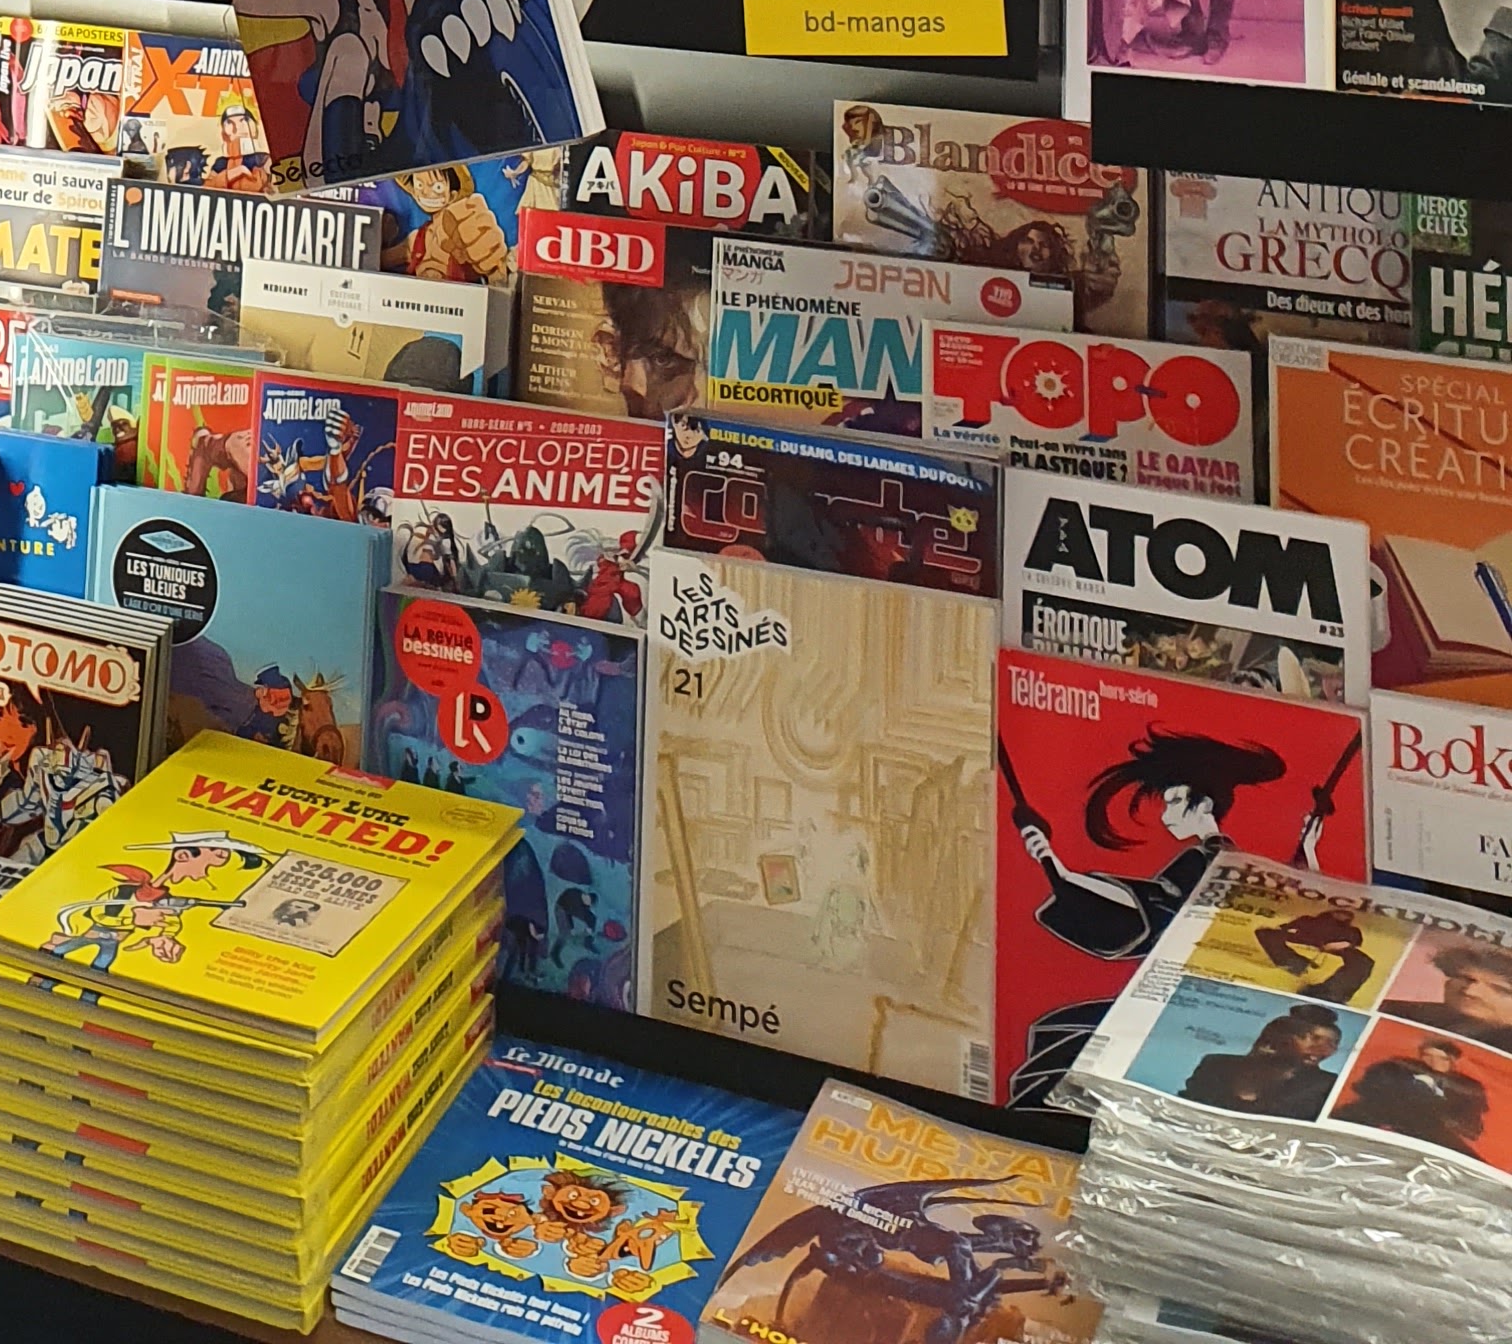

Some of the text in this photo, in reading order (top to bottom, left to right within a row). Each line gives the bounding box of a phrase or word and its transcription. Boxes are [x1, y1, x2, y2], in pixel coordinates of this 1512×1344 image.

[804, 10, 946, 40] bd-mangas
[1343, 70, 1485, 97] Géniale et scandaleuse
[1416, 216, 1469, 239] CELTES
[534, 225, 656, 275] dBD
[722, 252, 786, 274] MANGA
[263, 282, 309, 298] MEDIAPART
[933, 328, 1241, 446] TOPO
[1400, 373, 1504, 406] SPÉCIAL
[407, 433, 660, 472] ENCYCLOPÉDIE
[126, 559, 206, 588] LES TUNIQUES
[1023, 496, 1344, 625] ATOM
[143, 577, 187, 600] BLEUES
[1032, 597, 1127, 652] ÉROTIQUE
[674, 669, 704, 699] 21
[1007, 665, 1159, 721] Télérama hors-série
[185, 774, 457, 864] WANTED!
[257, 775, 411, 828] LUCKY LUKE
[664, 978, 782, 1036] Sempé
[533, 1078, 743, 1151] Les incontournables des
